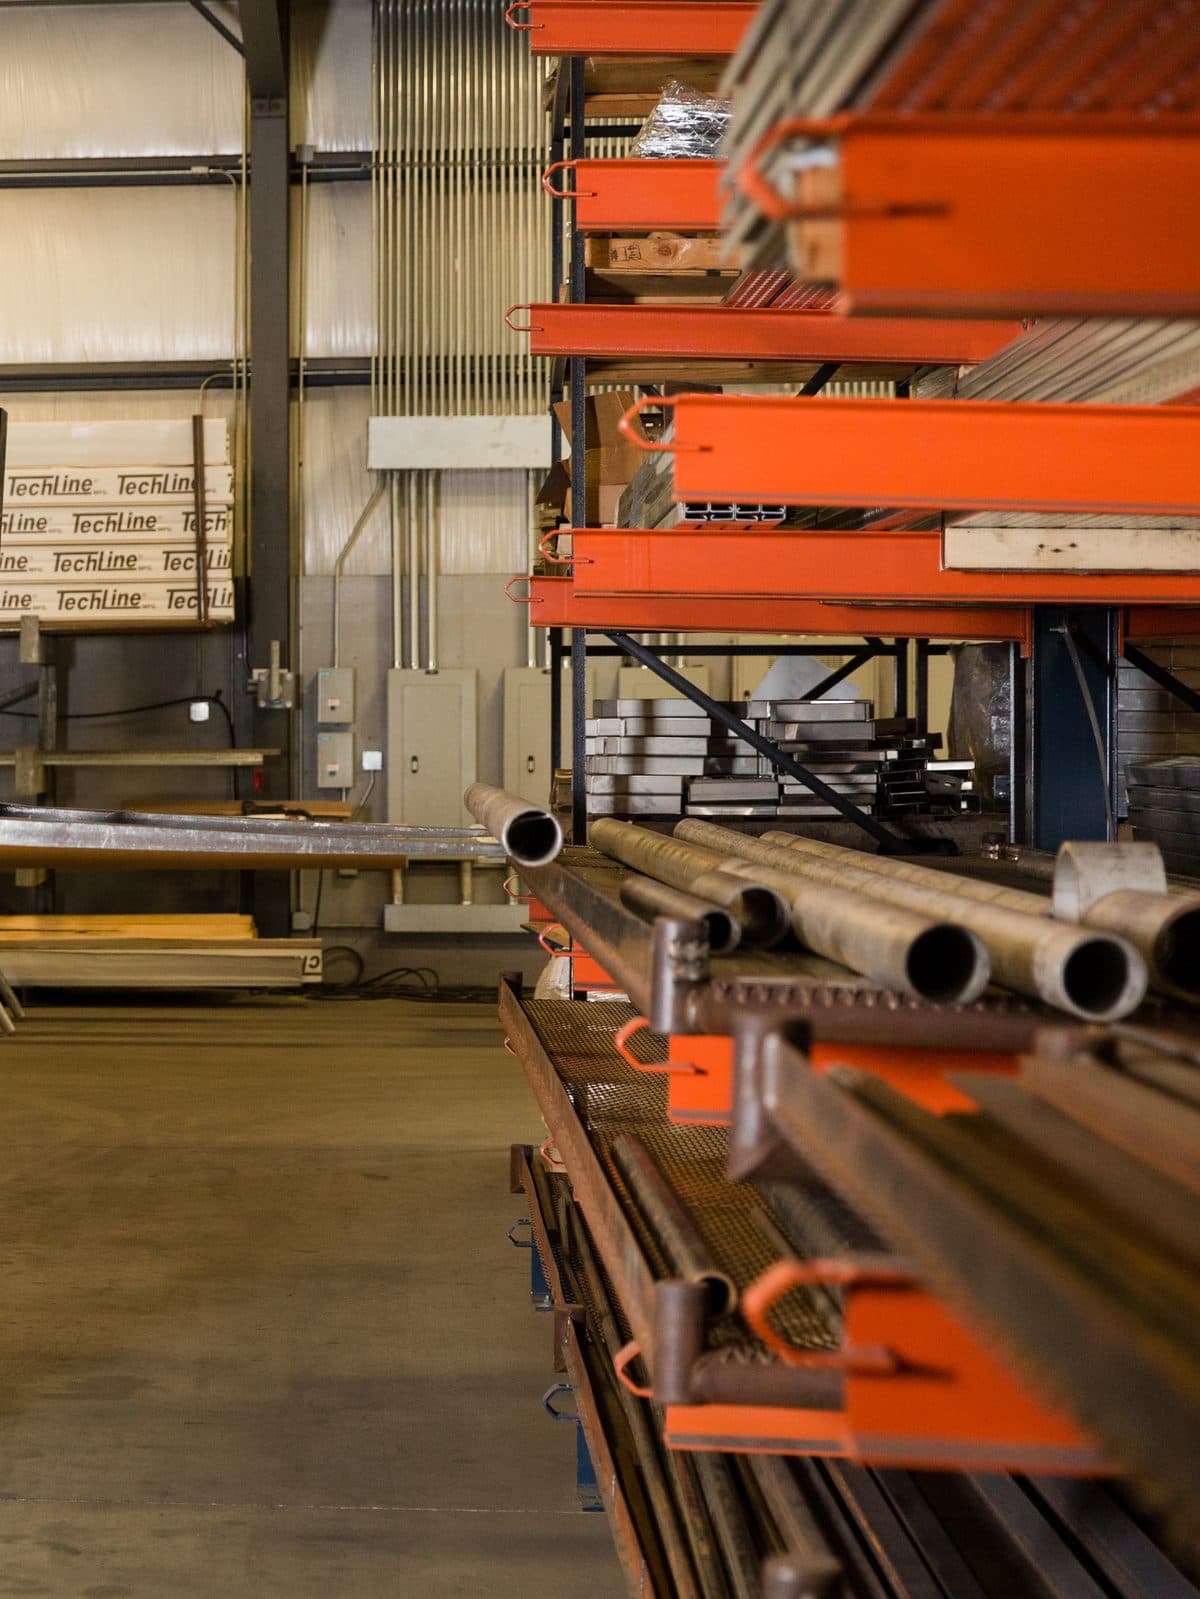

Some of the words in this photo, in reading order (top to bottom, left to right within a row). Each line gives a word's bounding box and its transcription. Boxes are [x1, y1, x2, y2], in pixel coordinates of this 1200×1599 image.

[8, 475, 93, 496] TechLine
[117, 473, 195, 494] TechLin
[72, 511, 157, 534] TechLine
[182, 511, 226, 532] Tech
[53, 551, 138, 572] TechLine
[57, 589, 142, 611] TechLine
